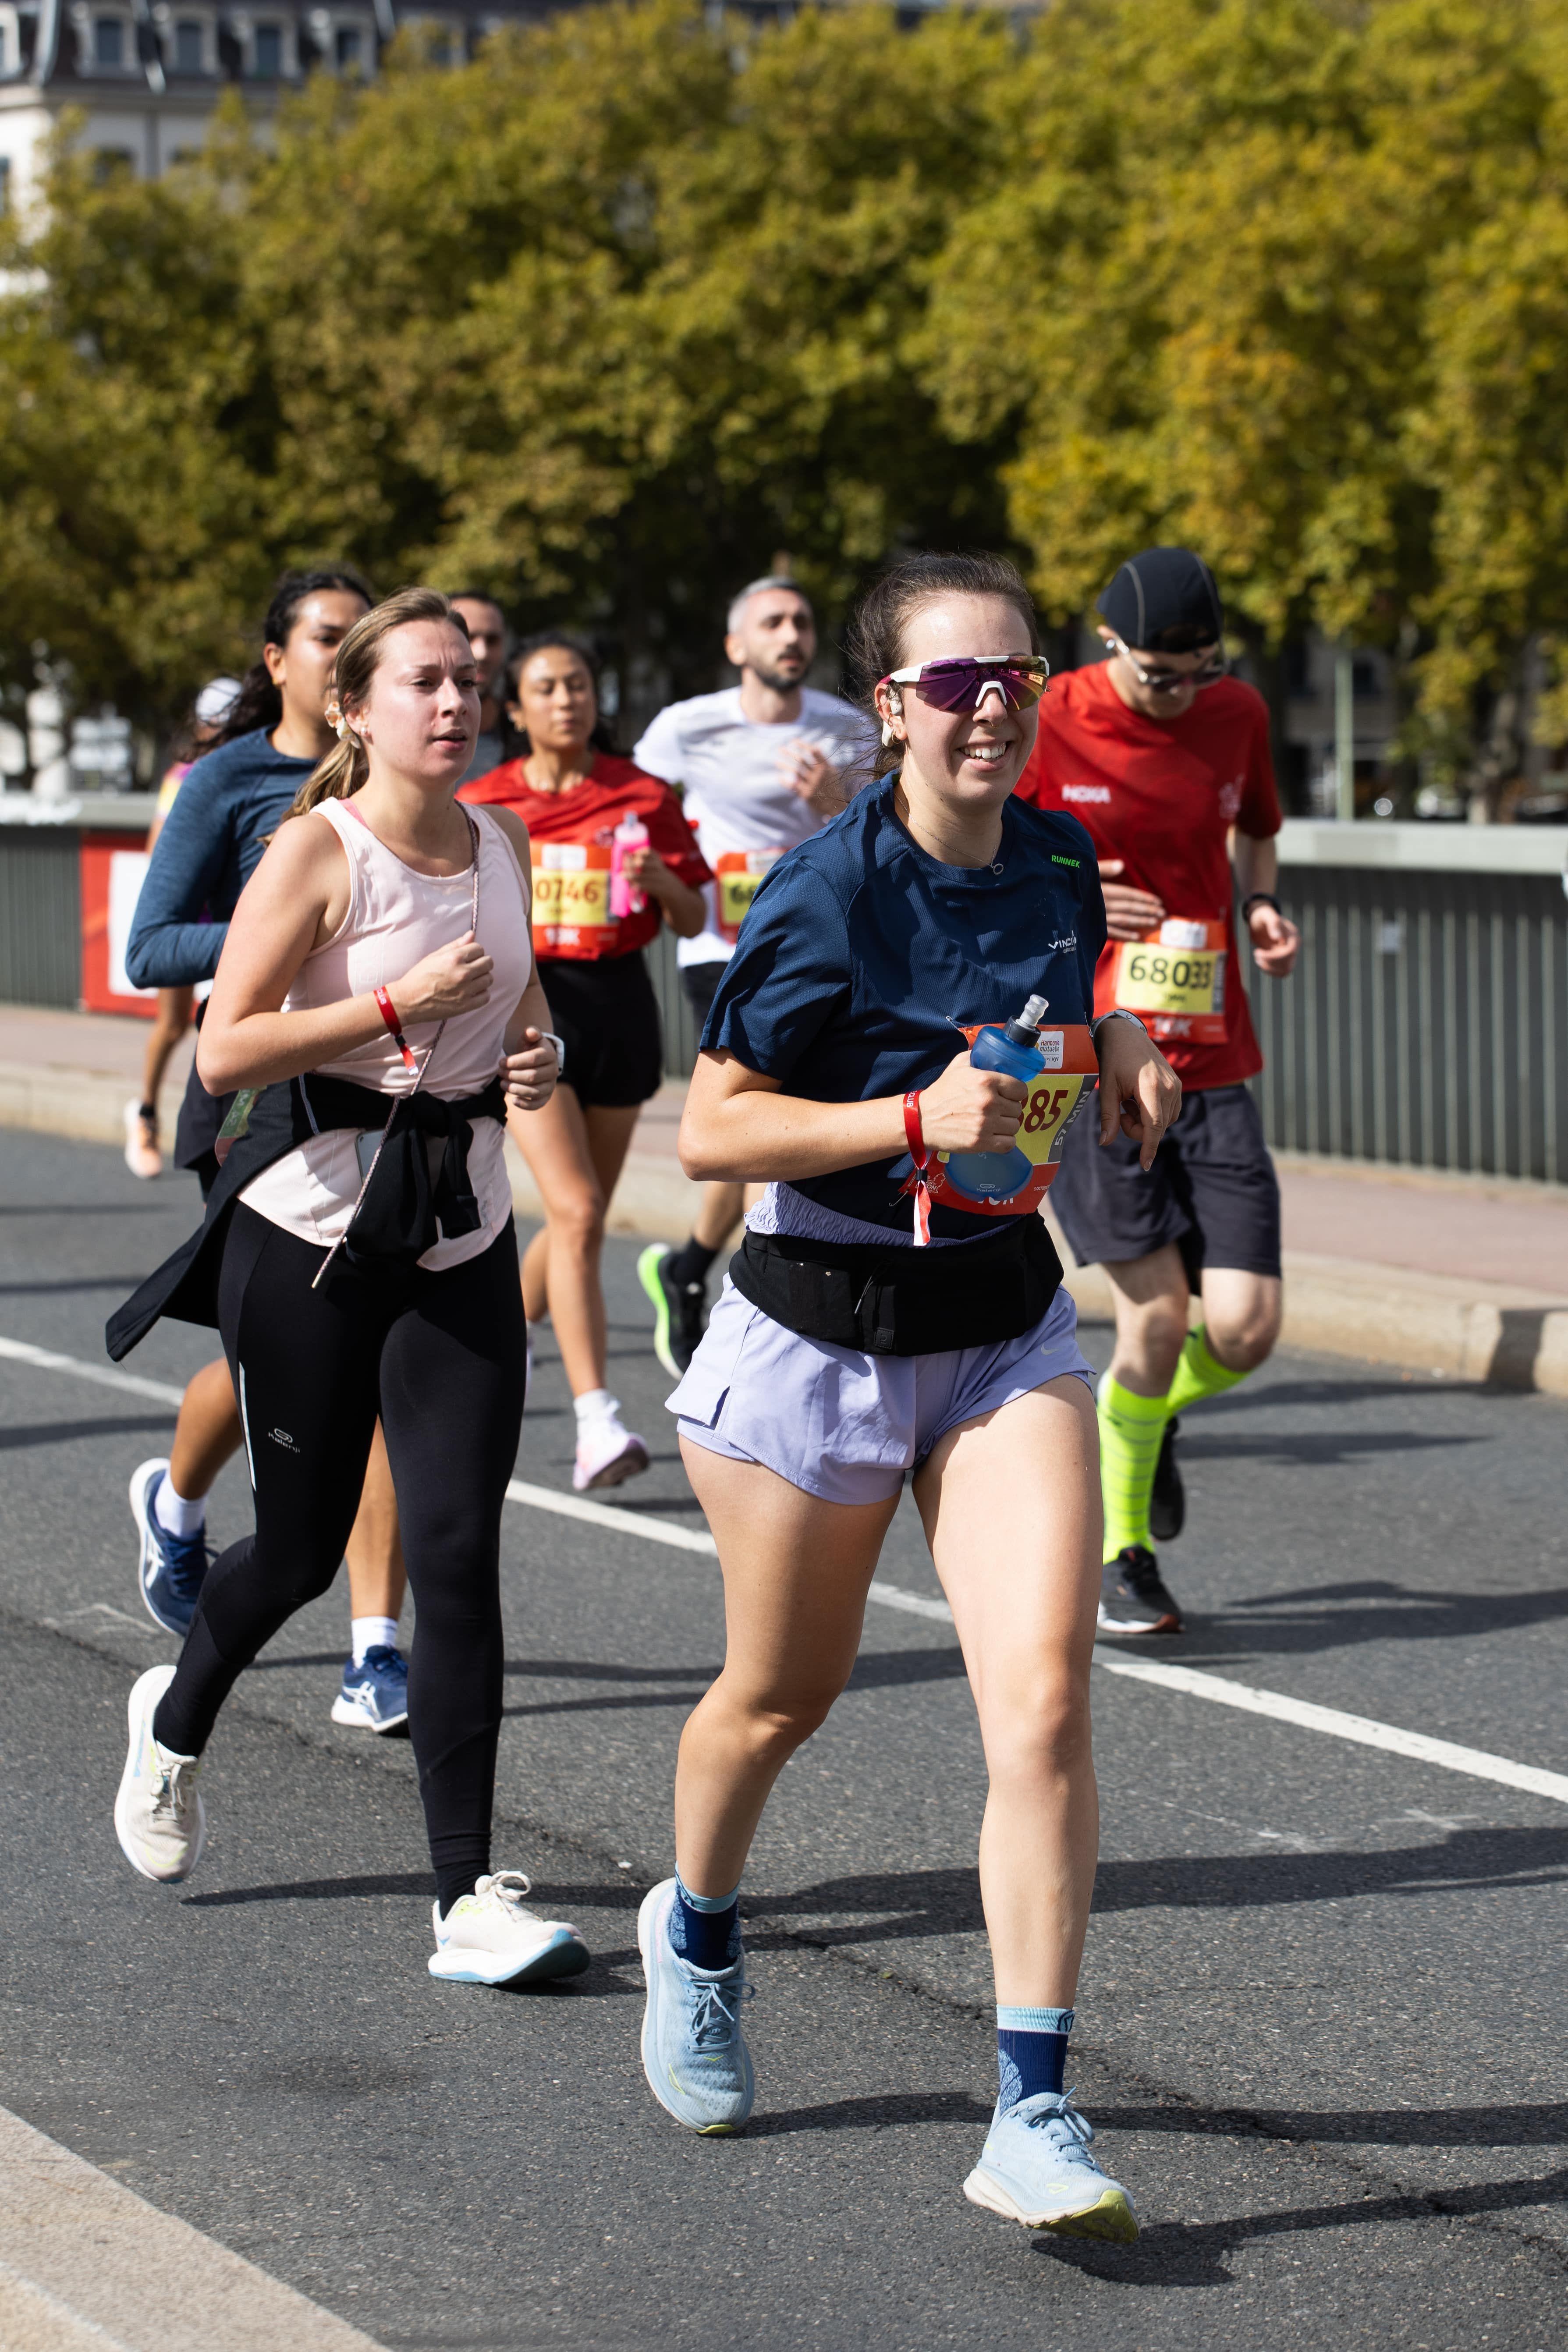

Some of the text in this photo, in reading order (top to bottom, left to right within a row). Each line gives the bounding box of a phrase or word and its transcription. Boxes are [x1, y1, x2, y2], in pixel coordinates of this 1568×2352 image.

[1052, 855, 1080, 868] RUNNEK
[906, 1093, 916, 1107] CLUB
[1066, 1091, 1091, 1123] MIN
